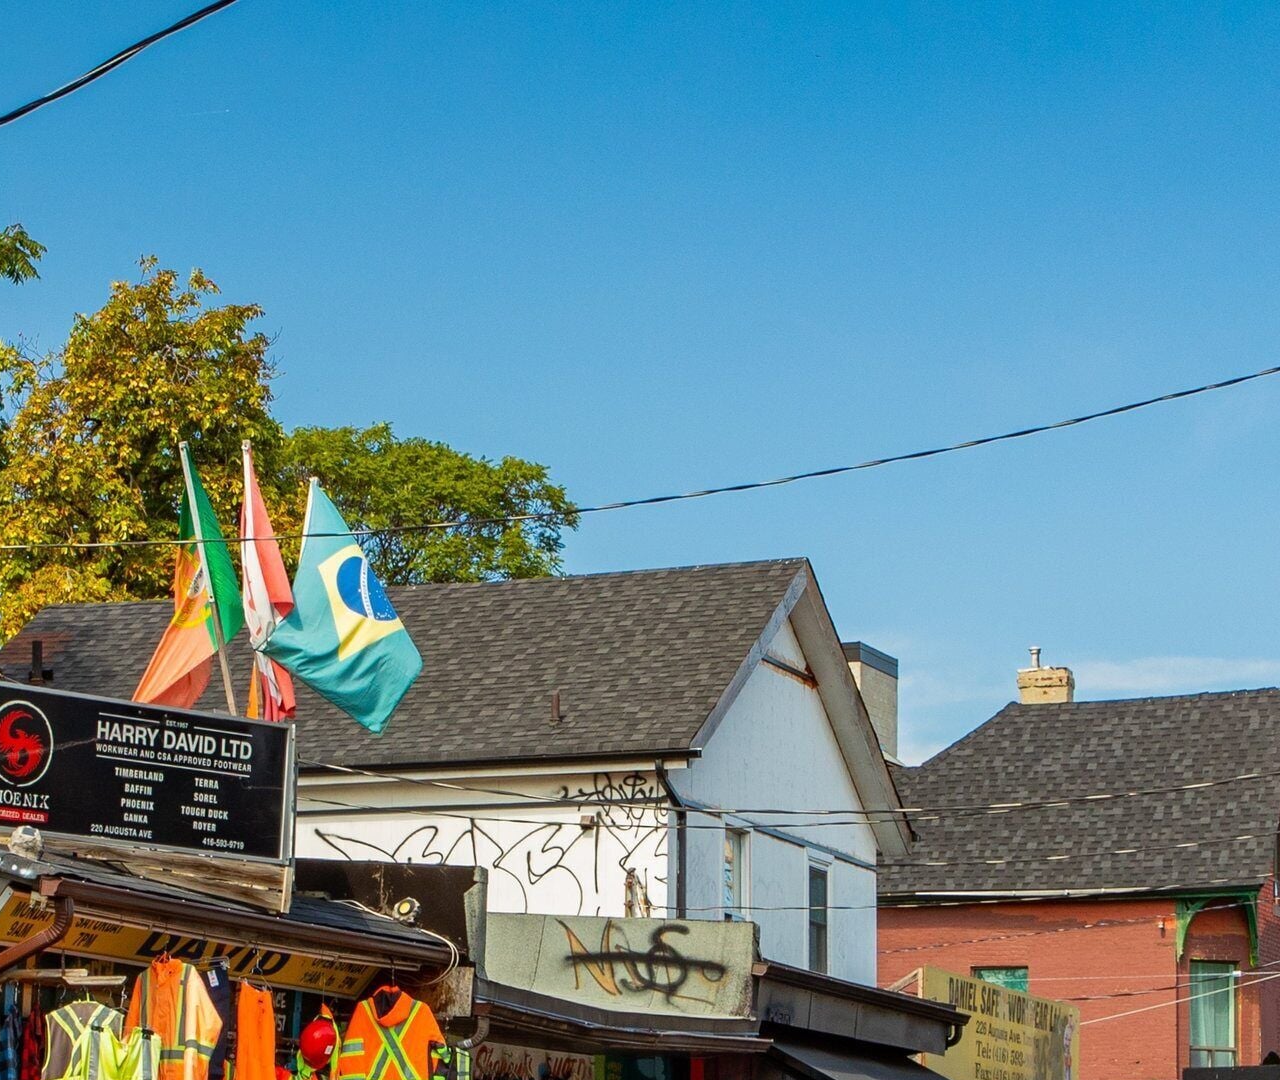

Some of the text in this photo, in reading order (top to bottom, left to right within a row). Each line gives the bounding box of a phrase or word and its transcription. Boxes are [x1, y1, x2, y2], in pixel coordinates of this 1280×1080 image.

[96, 720, 253, 760] HARRY DAVID LTD
[96, 743, 252, 772] WORKWEAR AND CSA APPROVED FOOTWEAR
[114, 767, 164, 782] TIMBERLAND
[124, 783, 152, 796] BAFFIN
[194, 778, 219, 790] TERRA
[121, 798, 154, 811] PHOENIX
[193, 793, 218, 804] SOREL
[22, 812, 45, 821] DEALER
[181, 806, 228, 820] TOUGH DUCK
[91, 824, 152, 839] 220 AUGUSTA AVE
[192, 821, 216, 832] ROYER
[10, 901, 55, 922] MONDAY
[6, 922, 34, 938] 9AM
[75, 918, 125, 934] SATURDAY
[73, 932, 98, 948] 7PM
[949, 977, 977, 1012] DANIEL
[976, 1040, 991, 1059] Tel:
[992, 1045, 1008, 1065] (416)
[975, 1062, 991, 1080] Fax:
